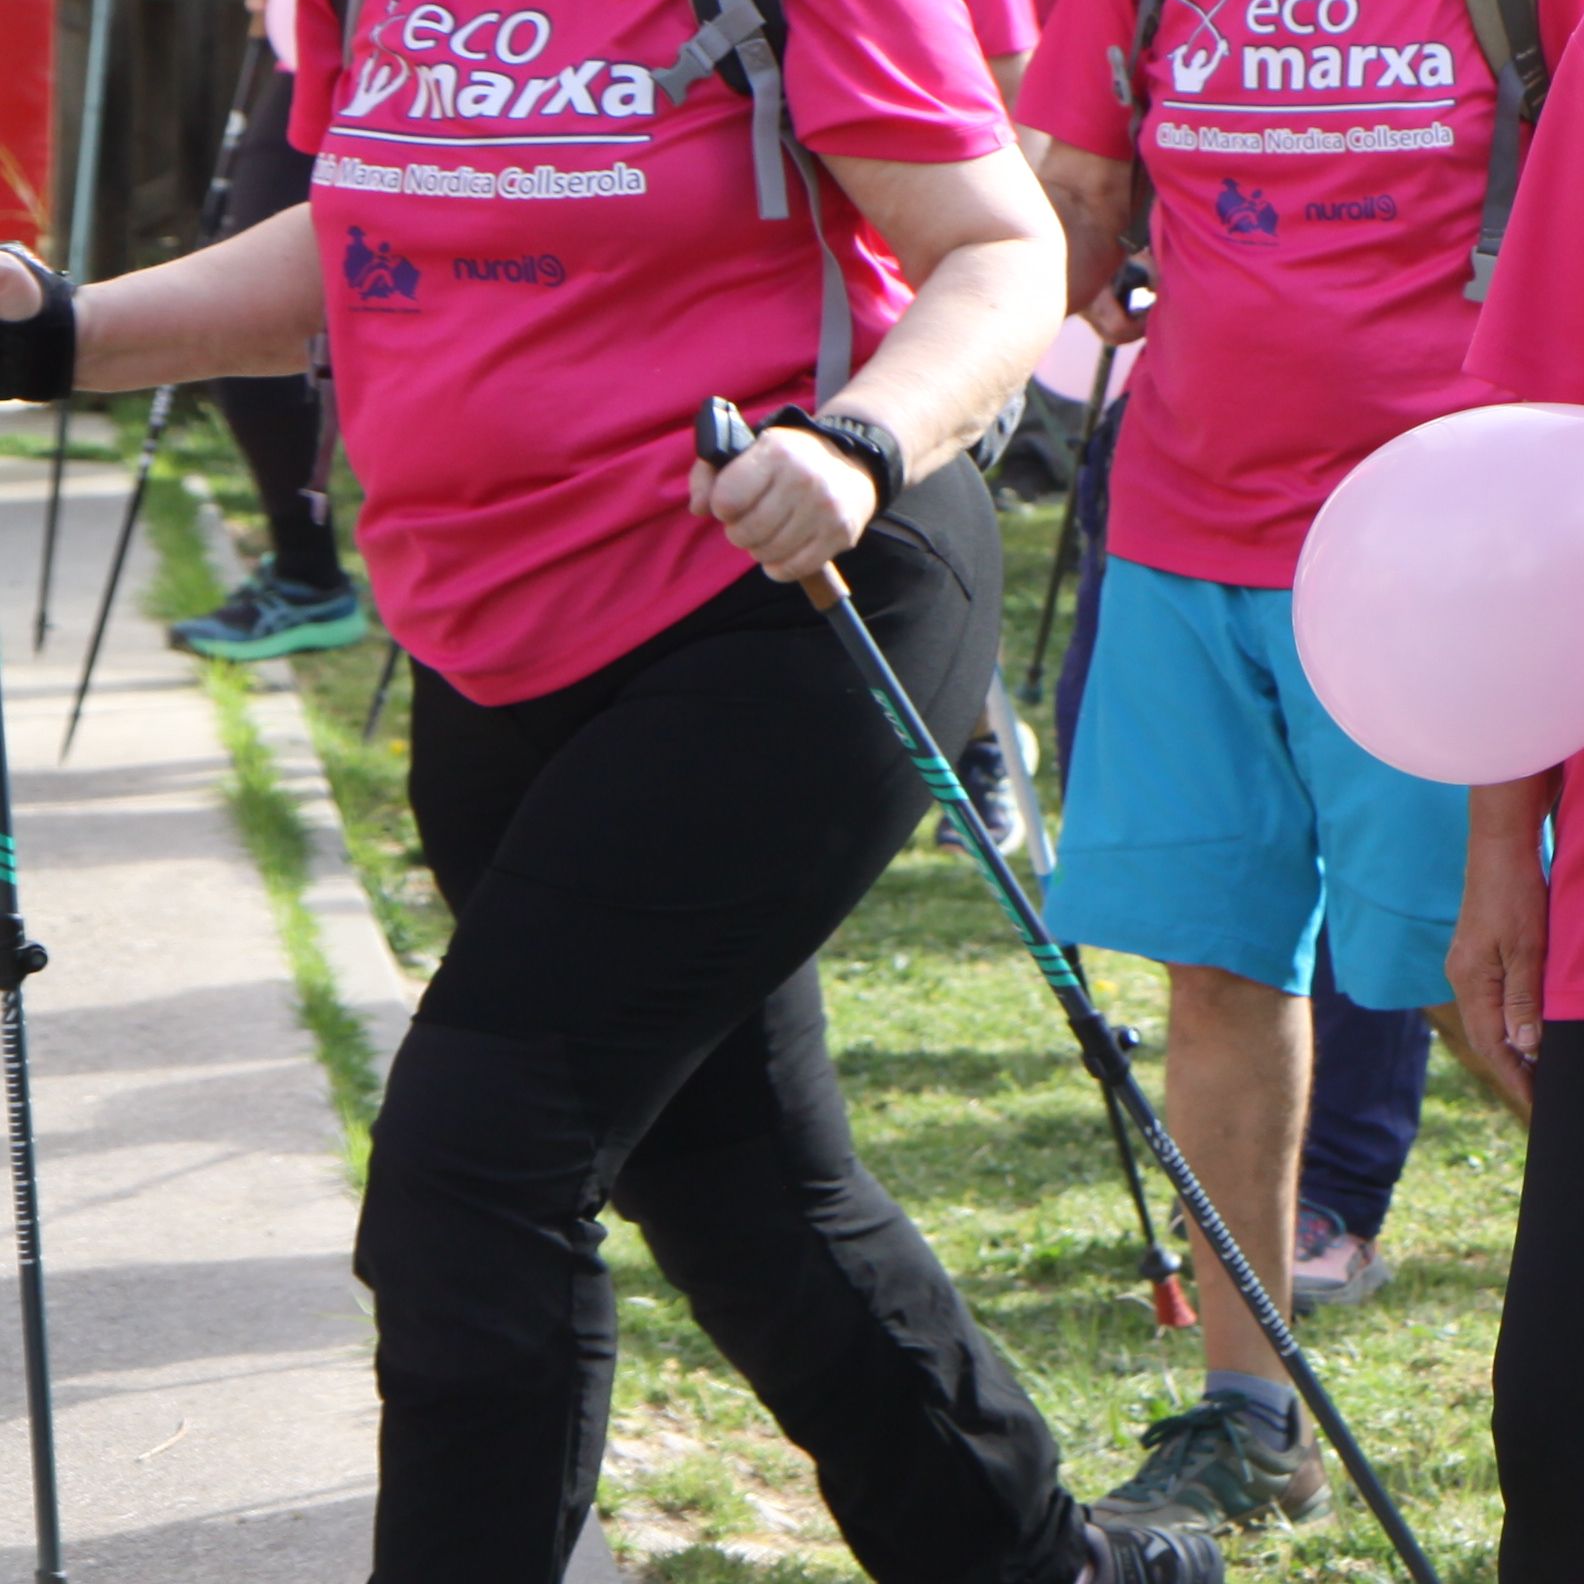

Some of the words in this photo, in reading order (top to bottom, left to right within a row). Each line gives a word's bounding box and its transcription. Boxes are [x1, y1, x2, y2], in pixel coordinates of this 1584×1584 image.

[403, 3, 551, 65] eco
[408, 60, 656, 119] marxa
[1242, 41, 1456, 91] marxa
[1157, 122, 1197, 151] Club
[1199, 126, 1262, 153] Marxa
[1264, 127, 1345, 155] Nòrdica
[1346, 121, 1454, 153] Collserola
[334, 157, 402, 193] Marxa
[498, 163, 647, 200] Collserola
